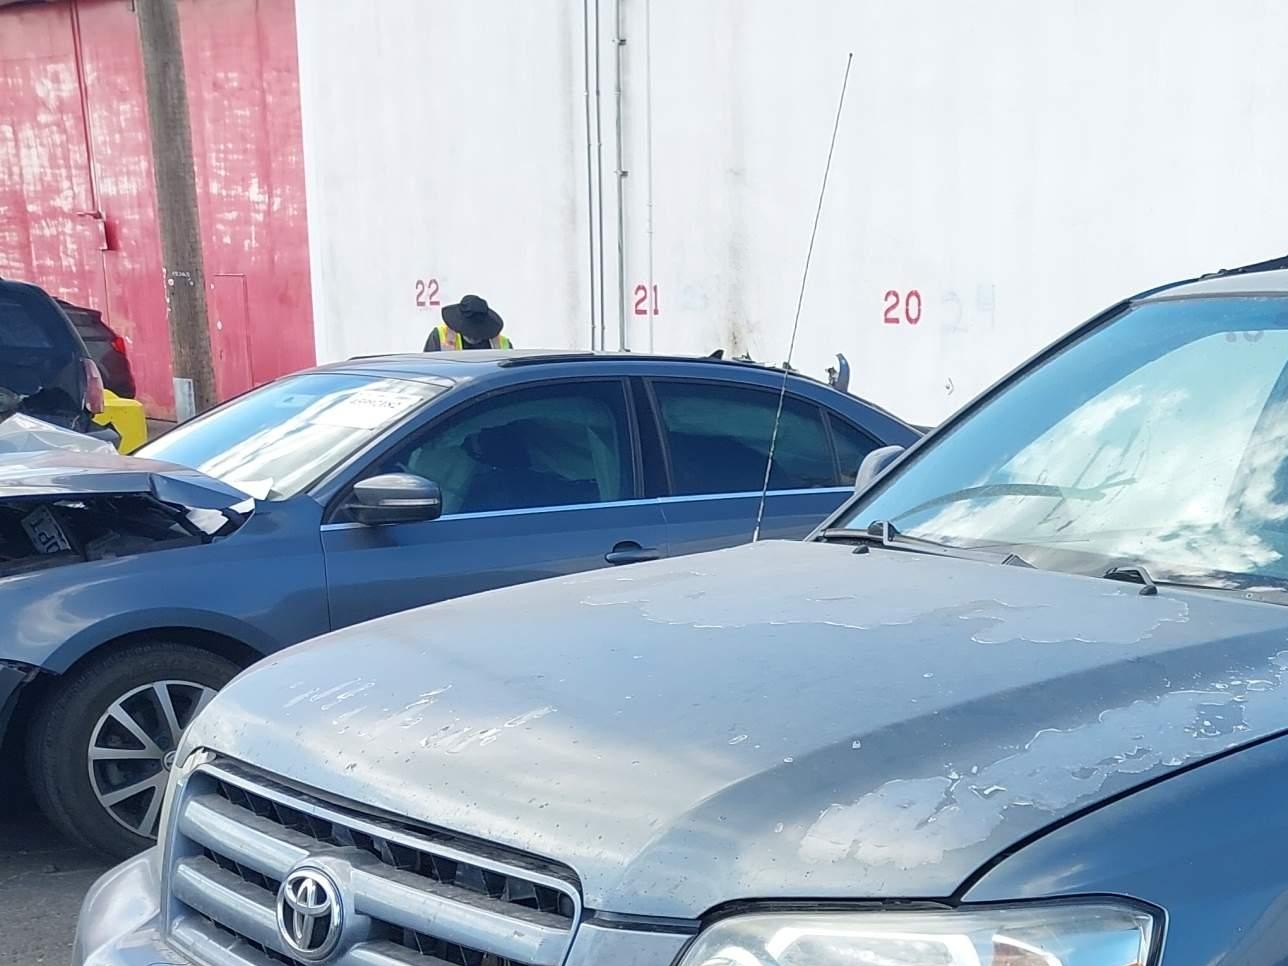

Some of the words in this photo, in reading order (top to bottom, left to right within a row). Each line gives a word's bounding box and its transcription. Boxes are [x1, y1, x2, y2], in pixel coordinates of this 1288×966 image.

[416, 279, 441, 307] 22
[634, 284, 659, 315] 21
[884, 290, 921, 324] 20
